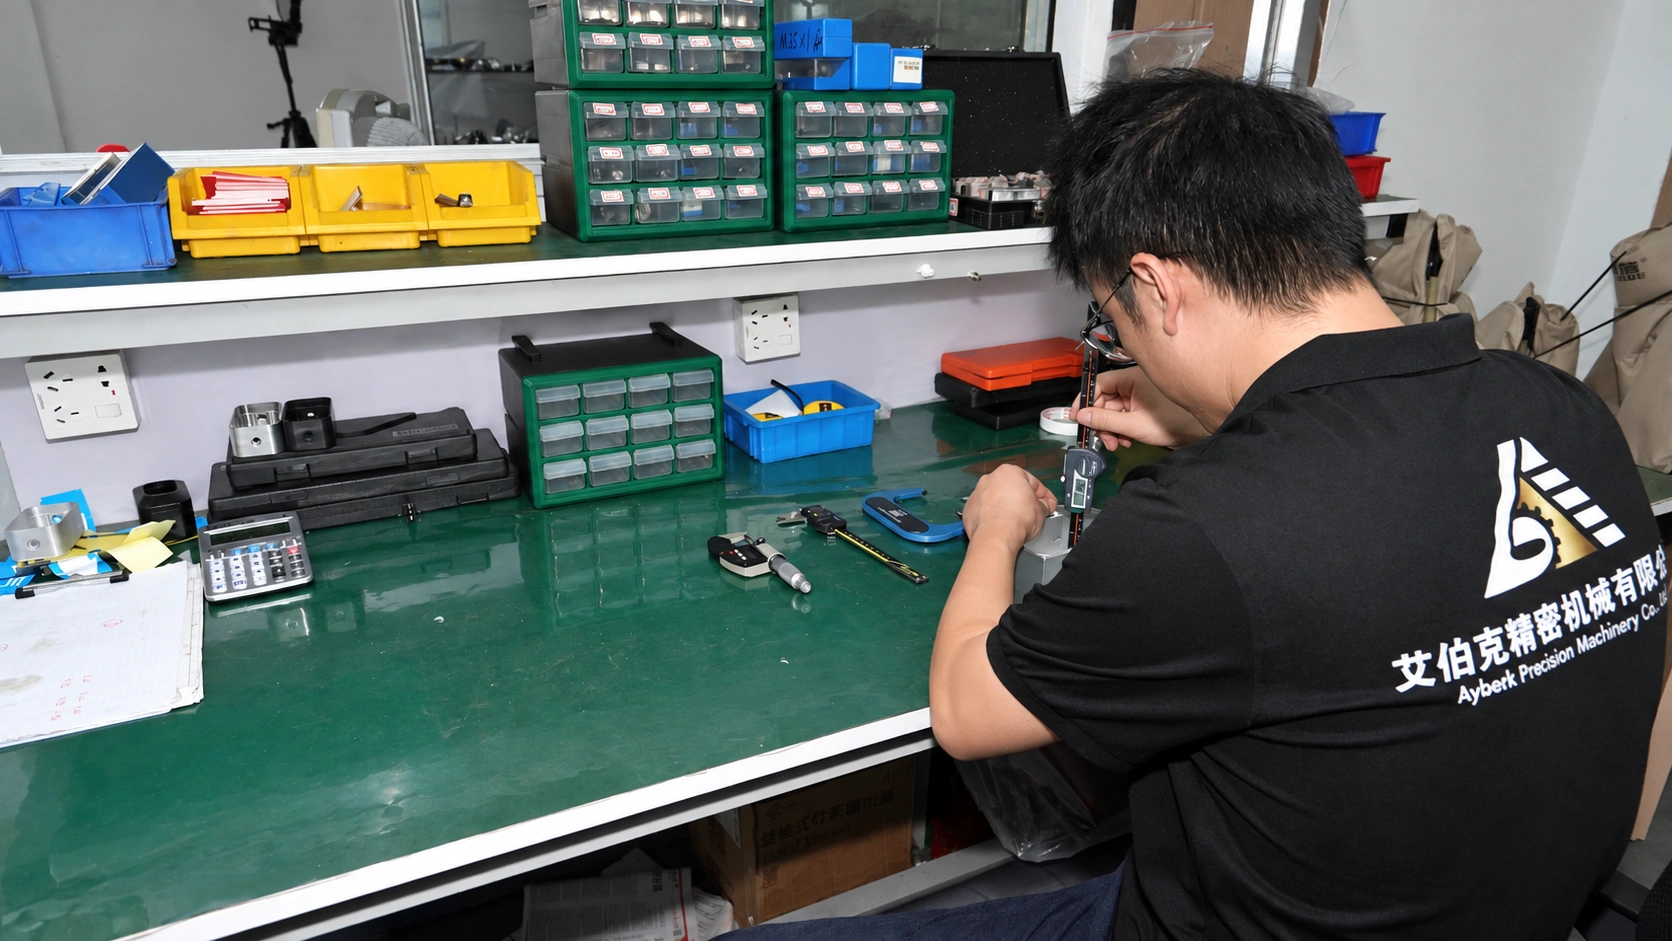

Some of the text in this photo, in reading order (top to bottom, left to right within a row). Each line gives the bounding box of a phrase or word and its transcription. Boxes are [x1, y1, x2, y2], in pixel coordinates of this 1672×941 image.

[1457, 669, 1518, 706] Ayberk
[1518, 645, 1575, 684] Precision
[1576, 613, 1640, 655] Machinery
